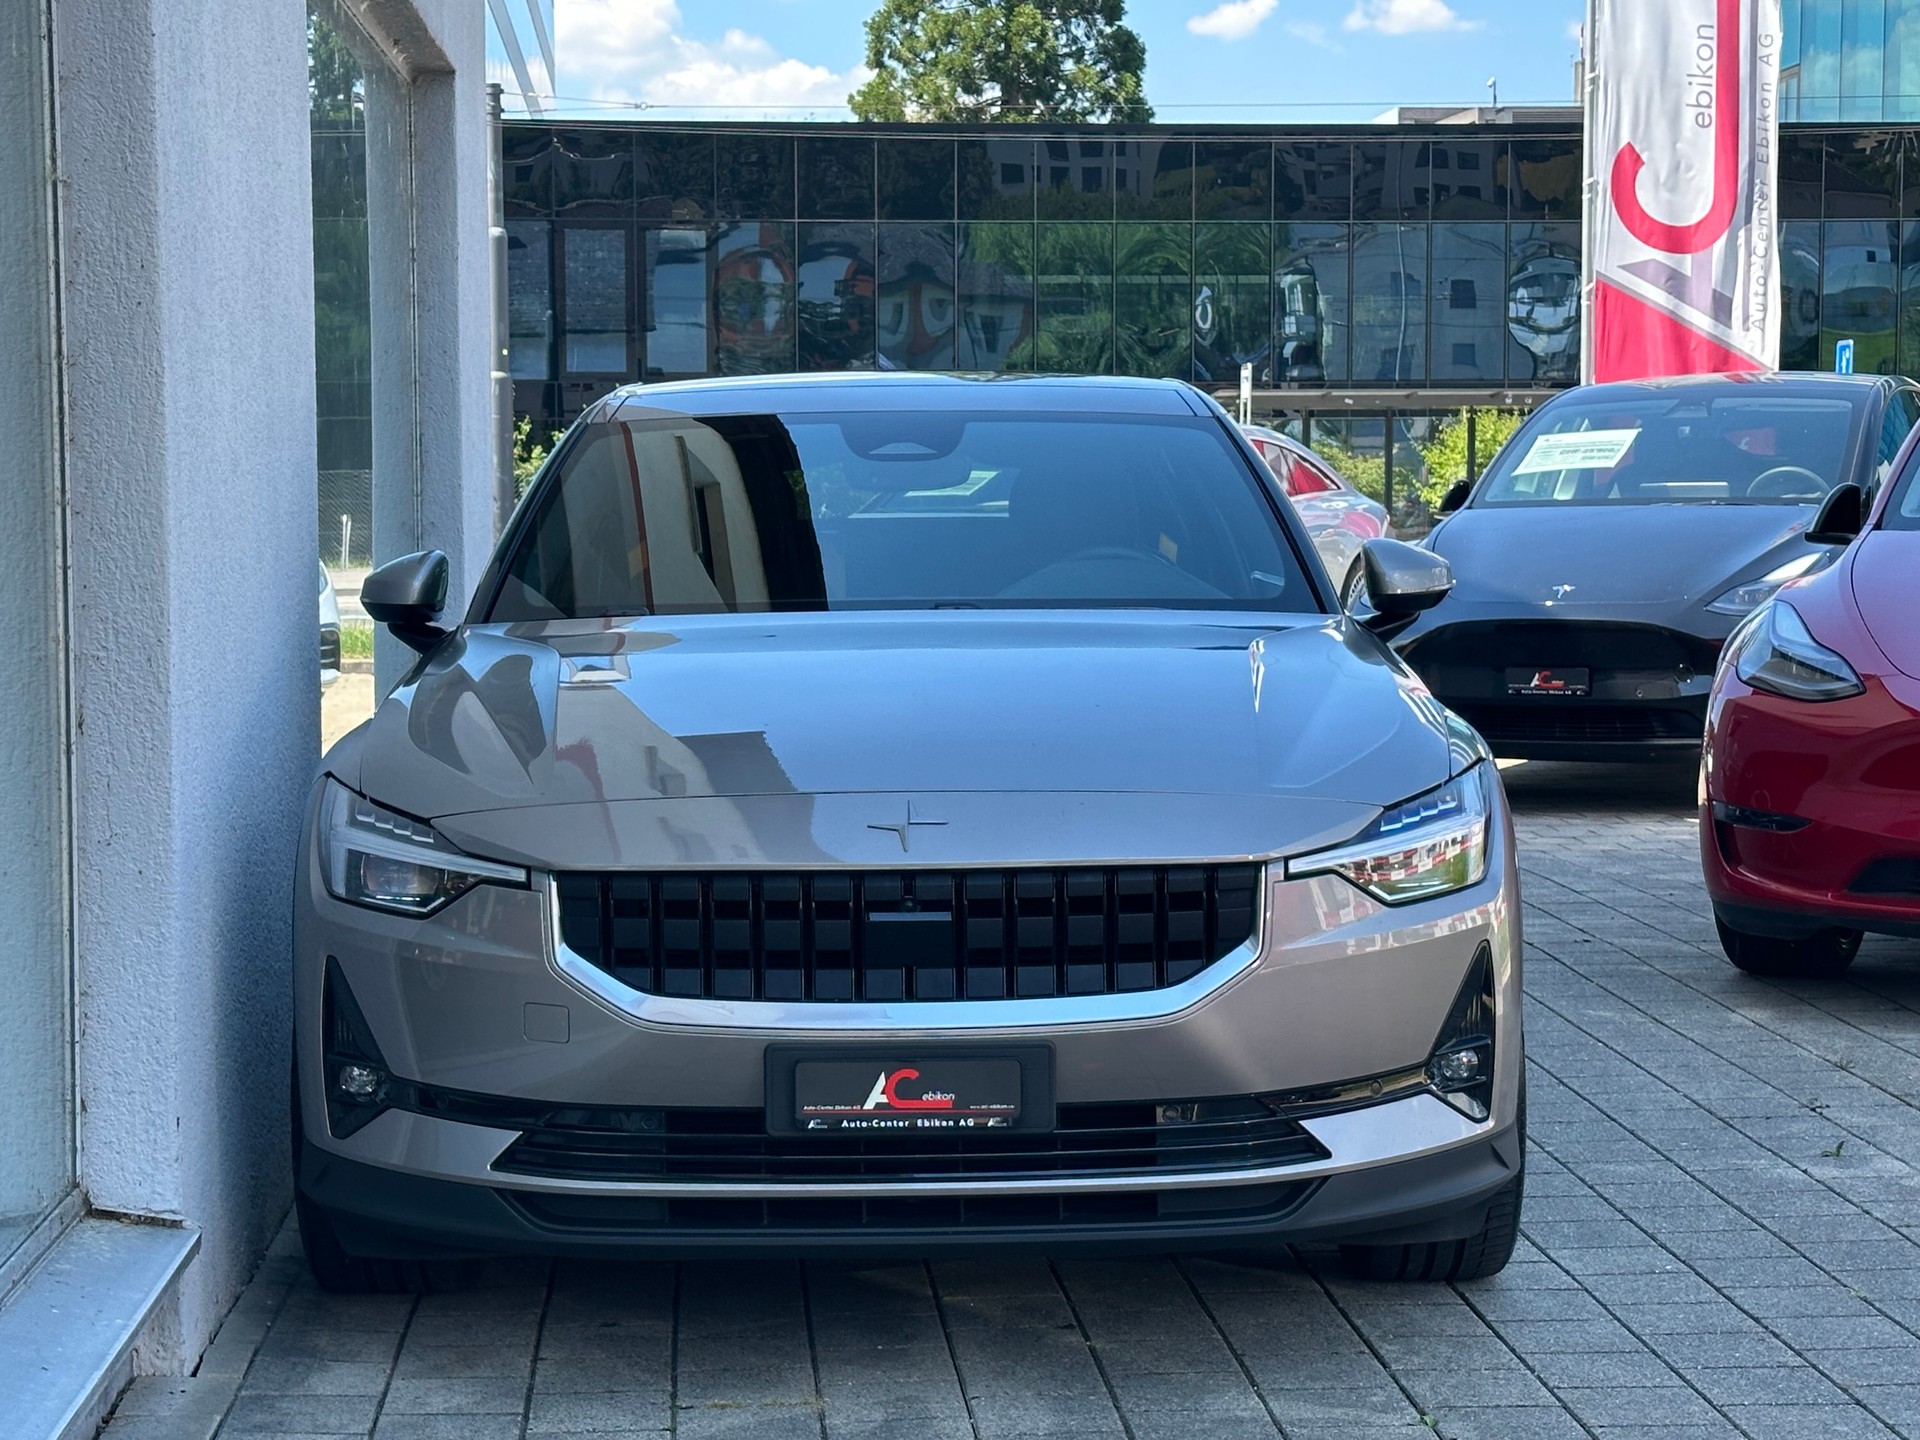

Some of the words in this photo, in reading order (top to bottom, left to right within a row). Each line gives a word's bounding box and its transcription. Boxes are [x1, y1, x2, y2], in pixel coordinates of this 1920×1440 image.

[1757, 32, 1774, 67] AG
[1685, 23, 1715, 129] ebikon
[1755, 81, 1773, 166] Ebikon
[1749, 178, 1770, 332] Auto-Center
[1530, 671, 1565, 688] AC
[862, 1068, 954, 1110] AC
[921, 1090, 955, 1101] ebikon
[841, 1118, 910, 1128] Auto-Center
[916, 1118, 954, 1127] Ebikon
[958, 1117, 975, 1127] AG
